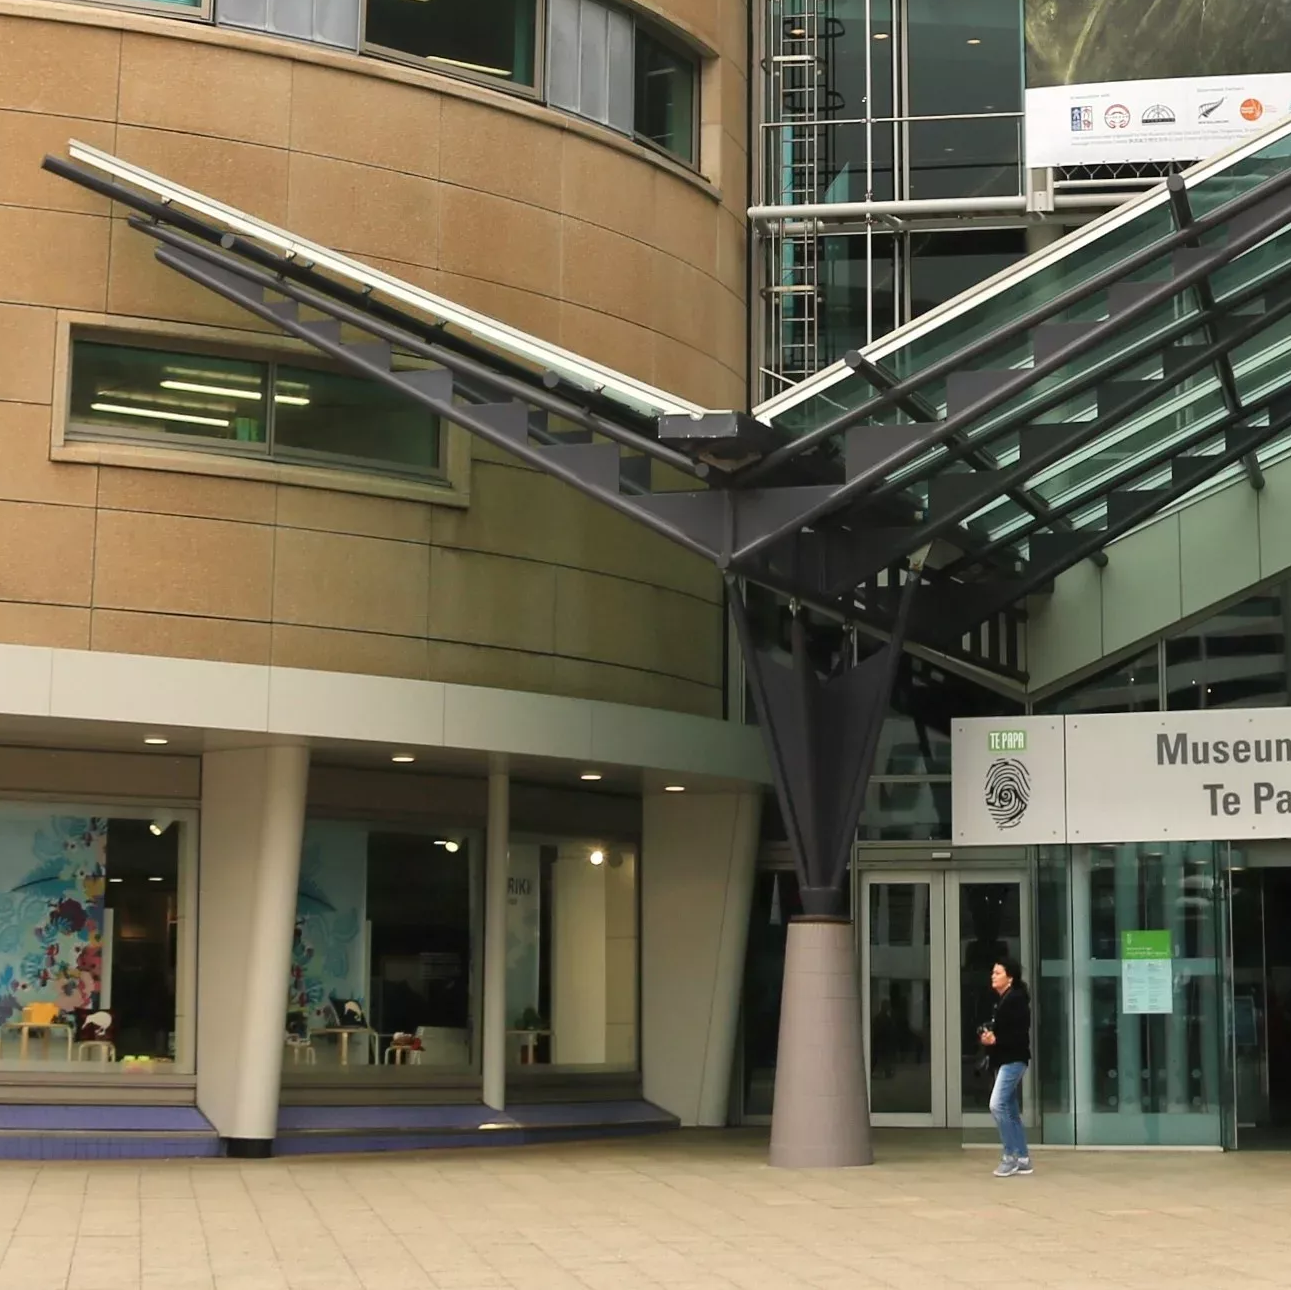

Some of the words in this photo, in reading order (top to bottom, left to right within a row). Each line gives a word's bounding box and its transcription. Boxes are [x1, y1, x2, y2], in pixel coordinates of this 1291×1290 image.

[989, 732, 1001, 750] TE
[1001, 731, 1024, 749] PAPA
[1203, 783, 1241, 816] Te
